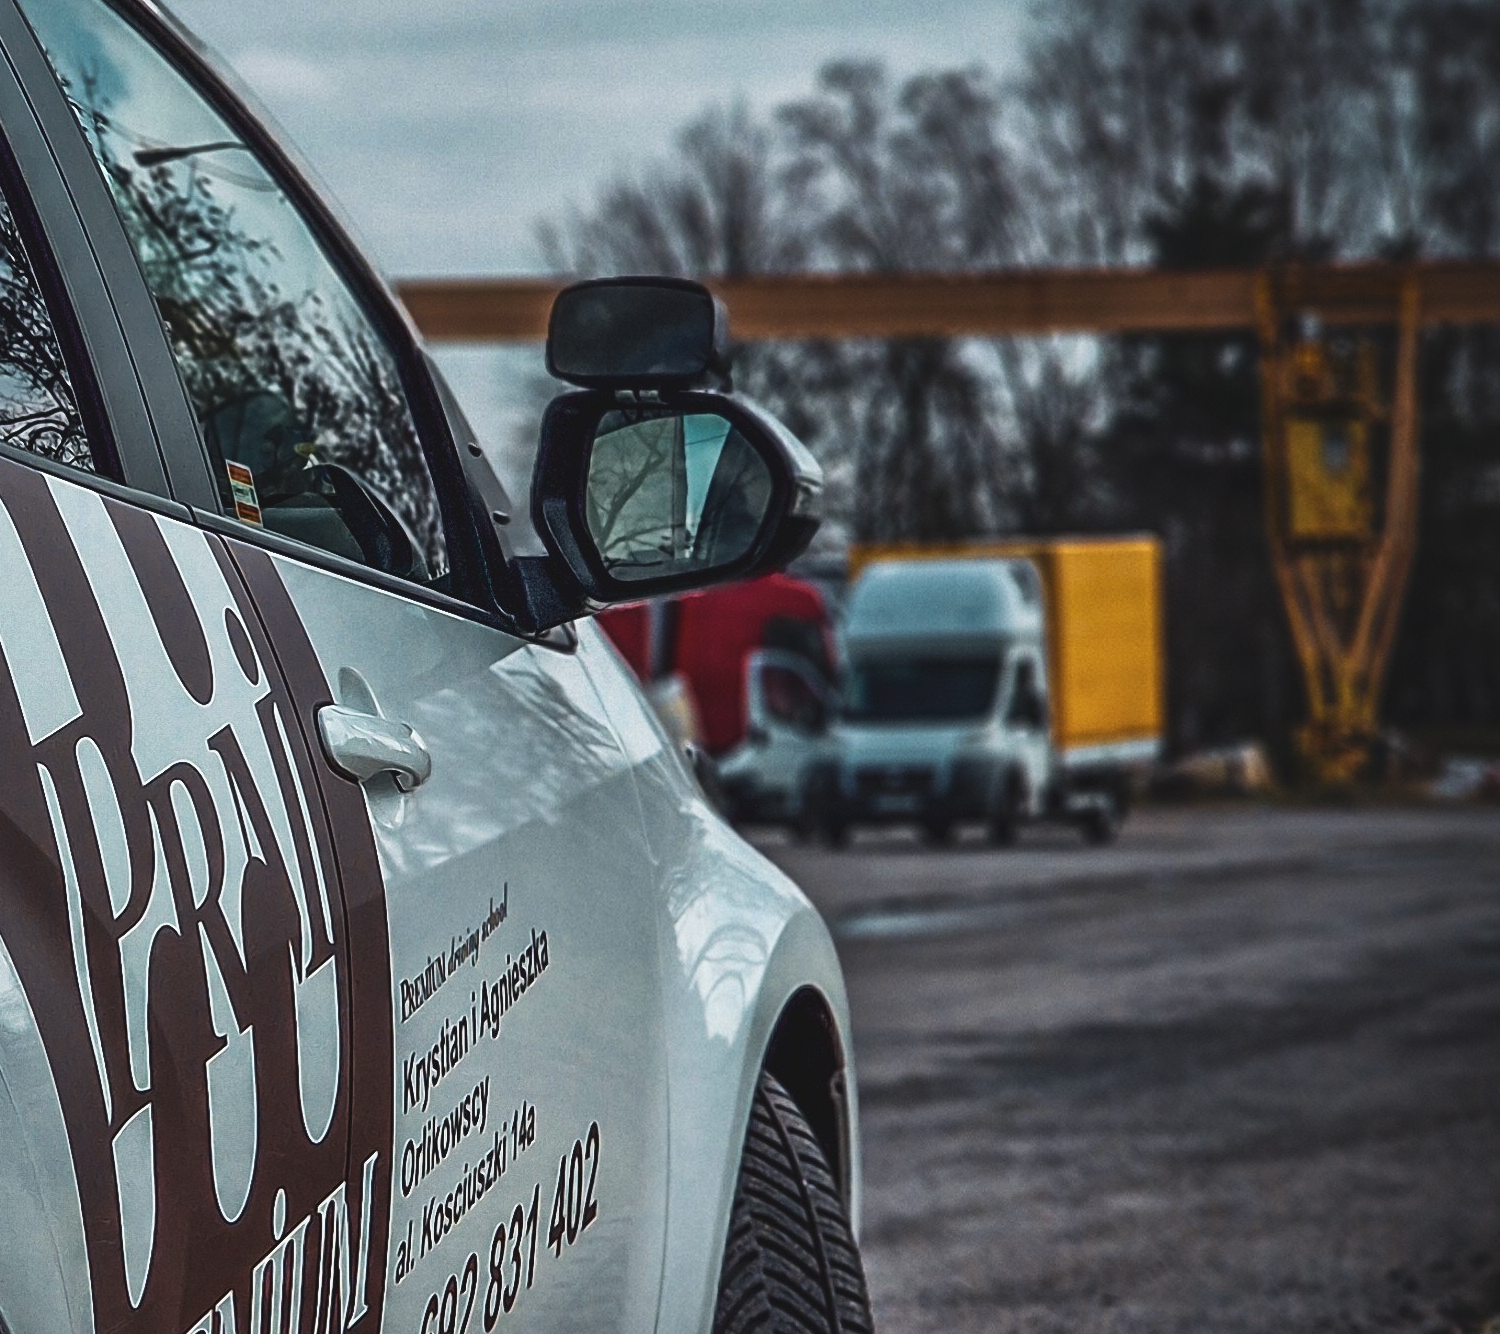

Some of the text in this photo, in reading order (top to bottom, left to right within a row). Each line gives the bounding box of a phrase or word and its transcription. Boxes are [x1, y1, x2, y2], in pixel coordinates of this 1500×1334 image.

[402, 926, 550, 1115] Krystian i Agnieszka
[395, 1099, 536, 1285] al. Kosciuszki 14a
[400, 1075, 490, 1198] Orlikowscy
[483, 1182, 540, 1334] 831
[547, 1120, 600, 1259] 402
